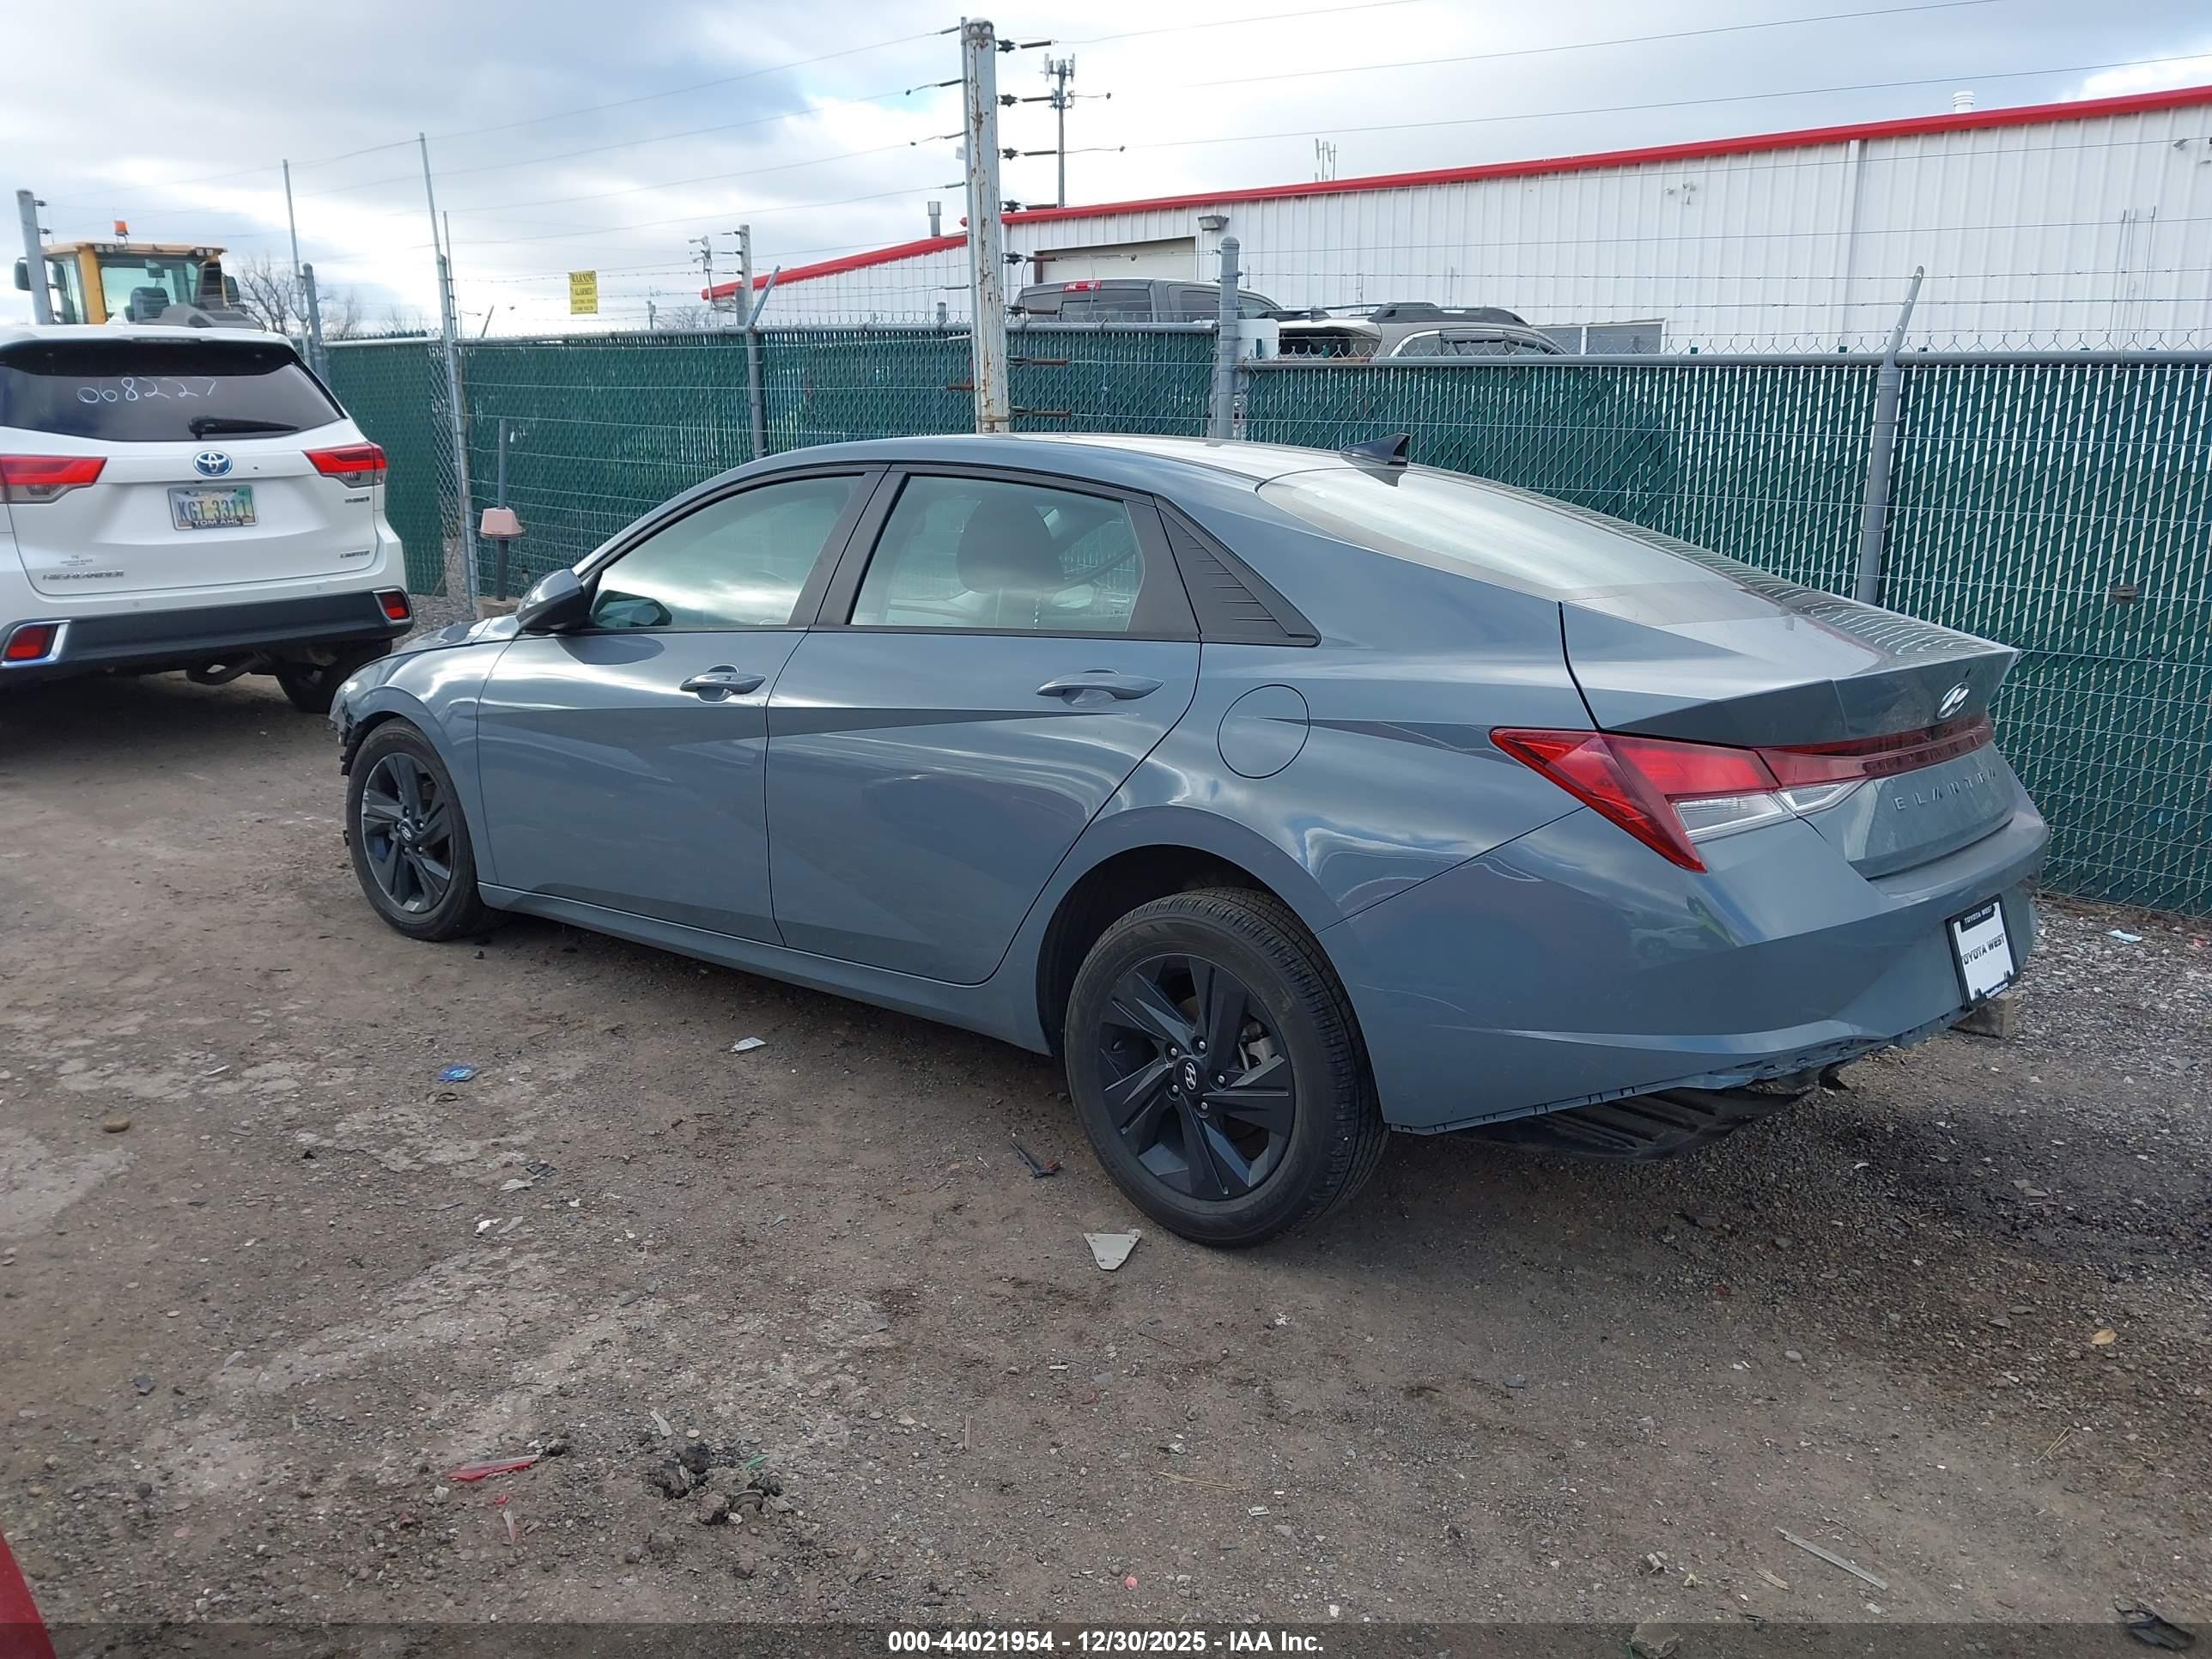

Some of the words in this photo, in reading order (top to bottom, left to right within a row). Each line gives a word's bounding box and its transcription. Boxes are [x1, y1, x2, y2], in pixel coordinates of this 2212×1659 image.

[76, 376, 216, 404] 068227
[42, 570, 125, 580] HIGHLANDER
[1892, 767, 1996, 811] ELANTRA
[1962, 945, 1988, 965] OYOTA
[1986, 933, 2005, 951] WEST
